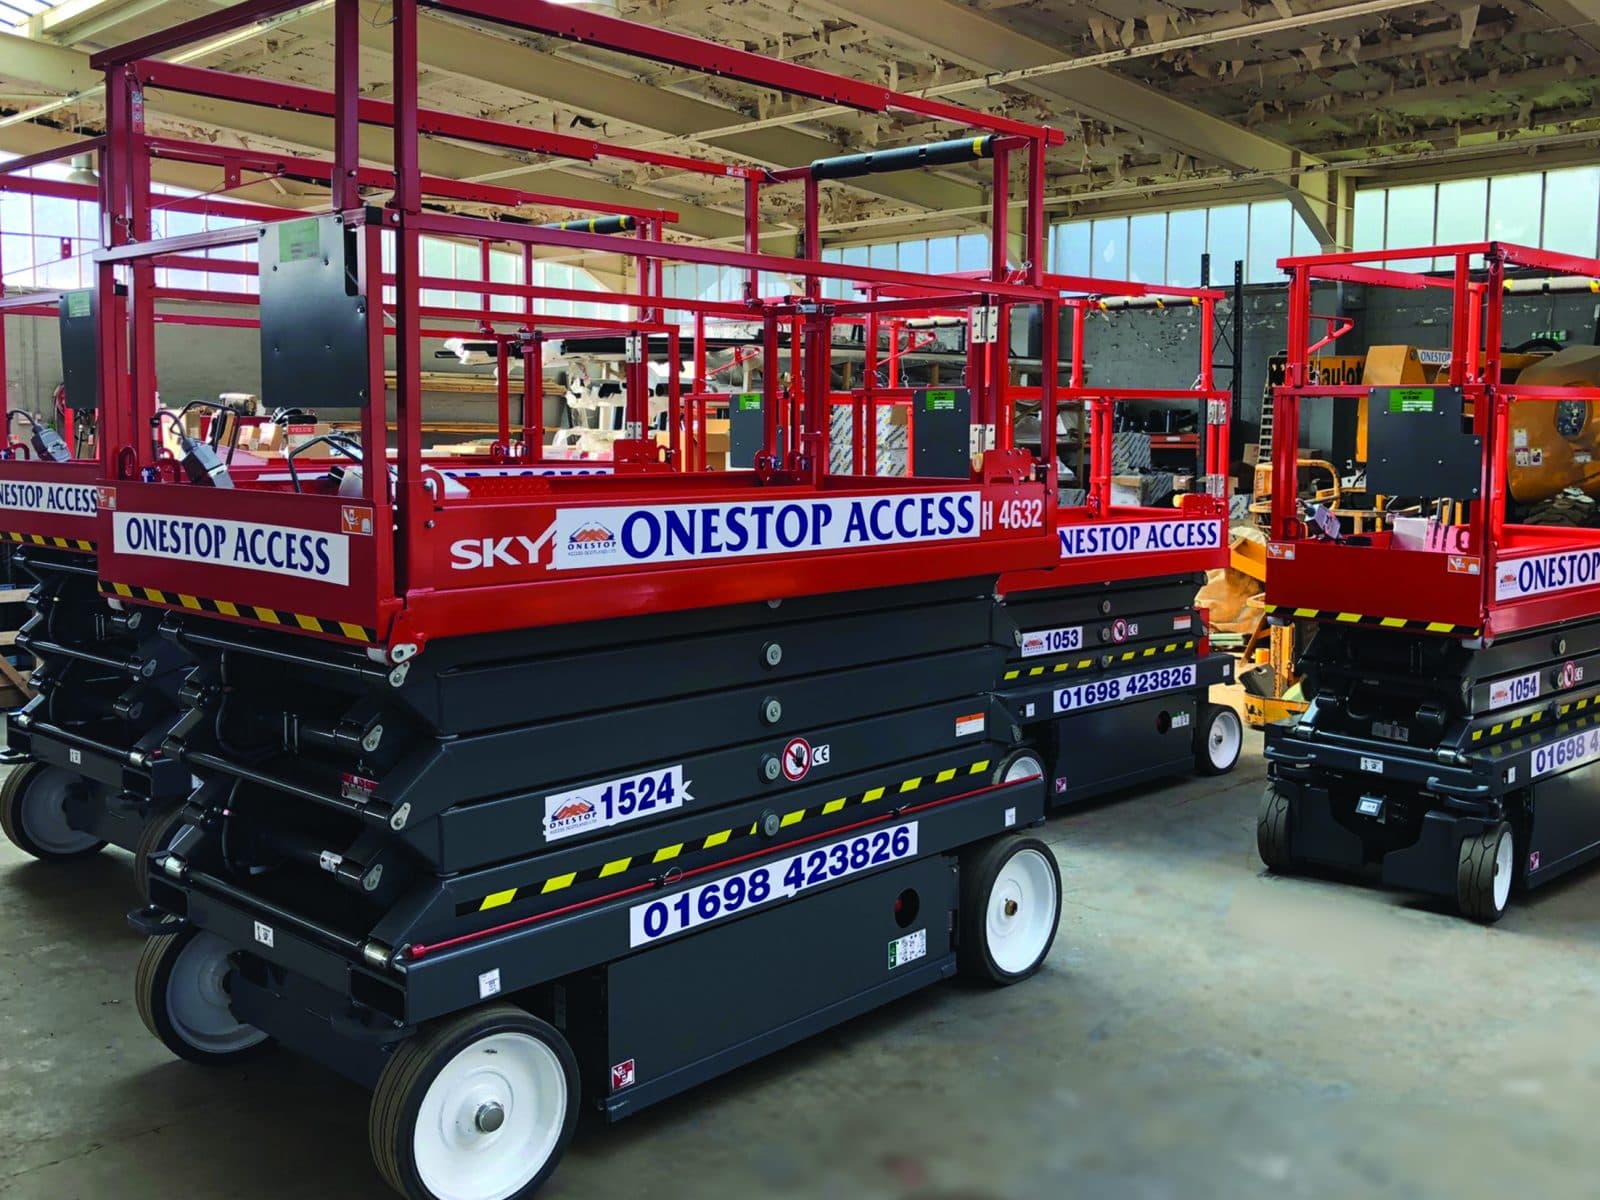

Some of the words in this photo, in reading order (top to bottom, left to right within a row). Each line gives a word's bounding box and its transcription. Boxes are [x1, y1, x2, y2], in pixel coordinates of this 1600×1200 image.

[47, 486, 97, 513] ACCESS
[999, 499, 1042, 529] 4632
[621, 504, 833, 560] ONESTOP
[844, 495, 974, 544] ACCESS
[1146, 522, 1217, 549] ACCESS
[126, 517, 226, 560] ONESTOP
[234, 527, 330, 576] ACCESS
[568, 541, 616, 551] ONESTOP
[1519, 551, 1600, 593] ONESTOP
[1045, 629, 1079, 651] 1053
[1060, 685, 1120, 709] 01698
[1126, 666, 1192, 696] 423826
[1509, 675, 1537, 702] 1054
[1536, 735, 1585, 773] 01698
[1590, 730, 1600, 752] 4
[601, 771, 675, 820] 1524
[550, 811, 597, 830] ONESTOP
[643, 868, 771, 938] 01698
[782, 826, 910, 892] 423826
